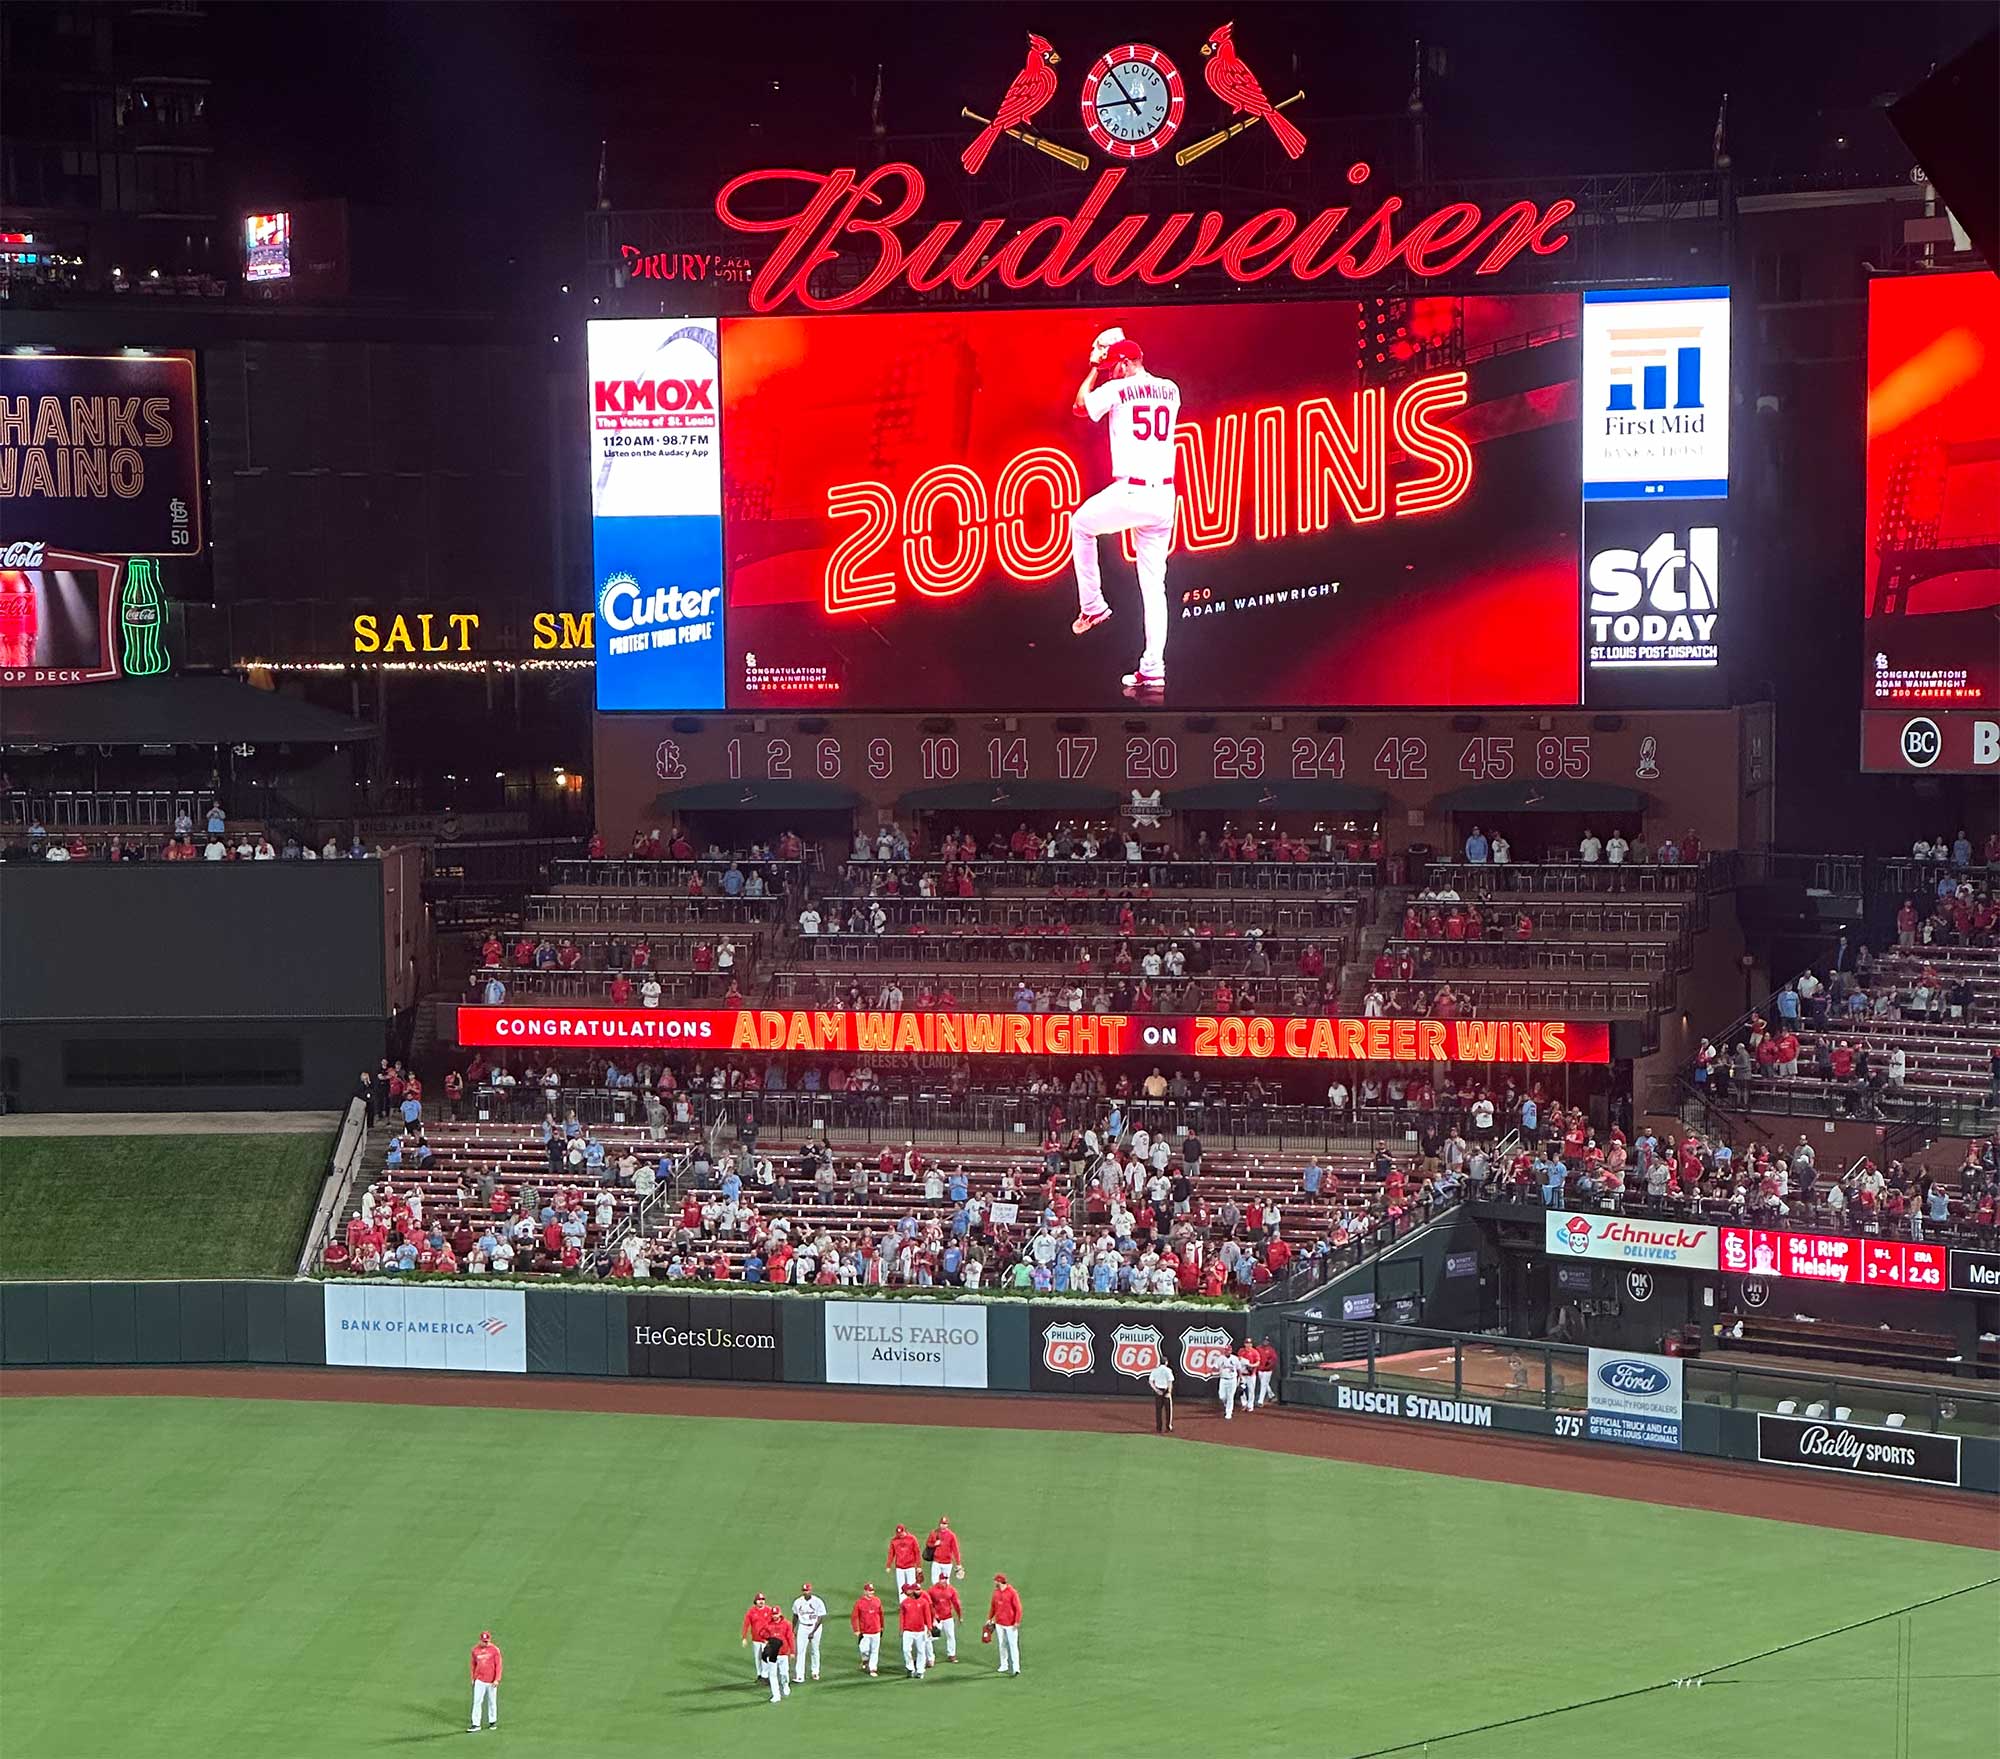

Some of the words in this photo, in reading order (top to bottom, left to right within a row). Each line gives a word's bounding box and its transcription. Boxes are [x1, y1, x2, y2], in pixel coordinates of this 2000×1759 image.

[1123, 64, 1160, 87] LOUIS
[1099, 105, 1165, 139] CARDINALS
[715, 162, 1576, 312] Budweiser
[595, 379, 714, 412] KMOX
[597, 417, 617, 428] The
[620, 416, 650, 428] Voice
[652, 416, 665, 427] of
[667, 415, 683, 427] St.
[685, 415, 714, 426] Louis
[1132, 405, 1170, 441] 50
[1605, 416, 1655, 435] First
[1661, 414, 1705, 434] Mid
[603, 436, 632, 446] 1120
[634, 436, 654, 446] AM
[662, 435, 688, 445] 98.7
[690, 434, 709, 445] FM
[604, 450, 629, 458] Listen
[658, 450, 690, 458] Audacy
[692, 450, 709, 458] App
[824, 446, 1082, 615] 200
[1118, 371, 1474, 562] WINS
[171, 530, 189, 545] 50
[1182, 588, 1212, 603] #50
[1182, 601, 1227, 618] ADAM
[1234, 582, 1341, 610] WAINWRIGHT
[603, 581, 721, 631] Cutter
[354, 613, 479, 653] SALT
[533, 612, 596, 650] SM
[1590, 614, 1718, 642] TODAY
[609, 632, 649, 656] PROTECT
[1607, 646, 1637, 659] LOUIS
[1638, 645, 1718, 659] POST-DISPATCH
[35, 671, 81, 681] DECK
[746, 667, 827, 675] CONGRATULATIONS
[746, 675, 770, 683] ADAM
[1875, 670, 1968, 679] CONGRATULATIONS
[1875, 680, 1901, 688] ADAM
[1905, 680, 1967, 688] WAINWRIGHT
[1875, 689, 1889, 697] ON
[1892, 689, 1911, 697] 200
[1914, 689, 1952, 697] CAREER
[1955, 689, 1982, 697] WINS
[1907, 731, 1935, 753] BC
[727, 739, 741, 779] 1
[766, 739, 792, 779] 2
[815, 738, 841, 779] 6
[867, 738, 893, 779] 9
[921, 738, 960, 779] 10
[987, 737, 1029, 779] 14
[1056, 737, 1098, 779] 17
[1126, 737, 1178, 779] 20
[1213, 737, 1265, 779] 23
[1291, 737, 1345, 779] 24
[1374, 737, 1428, 780] 42
[1458, 737, 1514, 780] 45
[1536, 736, 1591, 779] 85
[496, 1019, 712, 1038] CONGRATULATIONS
[731, 1011, 847, 1050] ADAM
[856, 1012, 1128, 1056] WAINWRIGHT
[1143, 1027, 1177, 1045] ON
[1195, 1017, 1275, 1058] 200
[1284, 1018, 1447, 1061] CAREER
[1456, 1020, 1567, 1063] WINS
[1597, 1222, 1708, 1249] Schnucks
[1623, 1245, 1677, 1261] DELIVERS
[1789, 1237, 1808, 1254] 56
[1817, 1240, 1849, 1259] RHP
[1914, 1252, 1932, 1263] ERA
[1631, 1272, 1649, 1288] DK
[1792, 1258, 1849, 1282] Helsley
[1909, 1266, 1940, 1284] 2.43
[1970, 1264, 2000, 1285] Mer
[341, 1319, 381, 1331] BANK
[385, 1320, 404, 1332] OF
[408, 1322, 475, 1335] AMERICA
[833, 1325, 904, 1343] WELLS
[909, 1327, 979, 1346] FARGO
[1051, 1330, 1086, 1341] PHILLIPS
[635, 1326, 776, 1349] HeGetsUs.com
[1120, 1332, 1155, 1343] PHILLIPS
[1188, 1335, 1224, 1346] PHILLIPS
[872, 1347, 942, 1364] Advisors
[1053, 1344, 1085, 1364] 66
[1121, 1346, 1152, 1366] 66
[1189, 1349, 1220, 1369] 66
[1612, 1364, 1657, 1391] Ford
[1338, 1385, 1399, 1416] BUSCH
[1406, 1394, 1492, 1427] STADIUM
[1608, 1399, 1632, 1409] QUALITY
[1633, 1401, 1650, 1411] FORD
[1651, 1404, 1678, 1414] DEALERS
[1590, 1416, 1621, 1429] OFFICIAL
[1622, 1420, 1645, 1431] TRUCK
[1645, 1423, 1662, 1434] AND
[1663, 1425, 1678, 1435] CAR
[1590, 1425, 1600, 1434] OF
[1600, 1427, 1613, 1436] THE
[1623, 1430, 1642, 1440] LOUIS
[1642, 1432, 1678, 1444] CARDINALS
[1800, 1425, 1867, 1468] Bally
[1866, 1443, 1915, 1466] SPORTS
